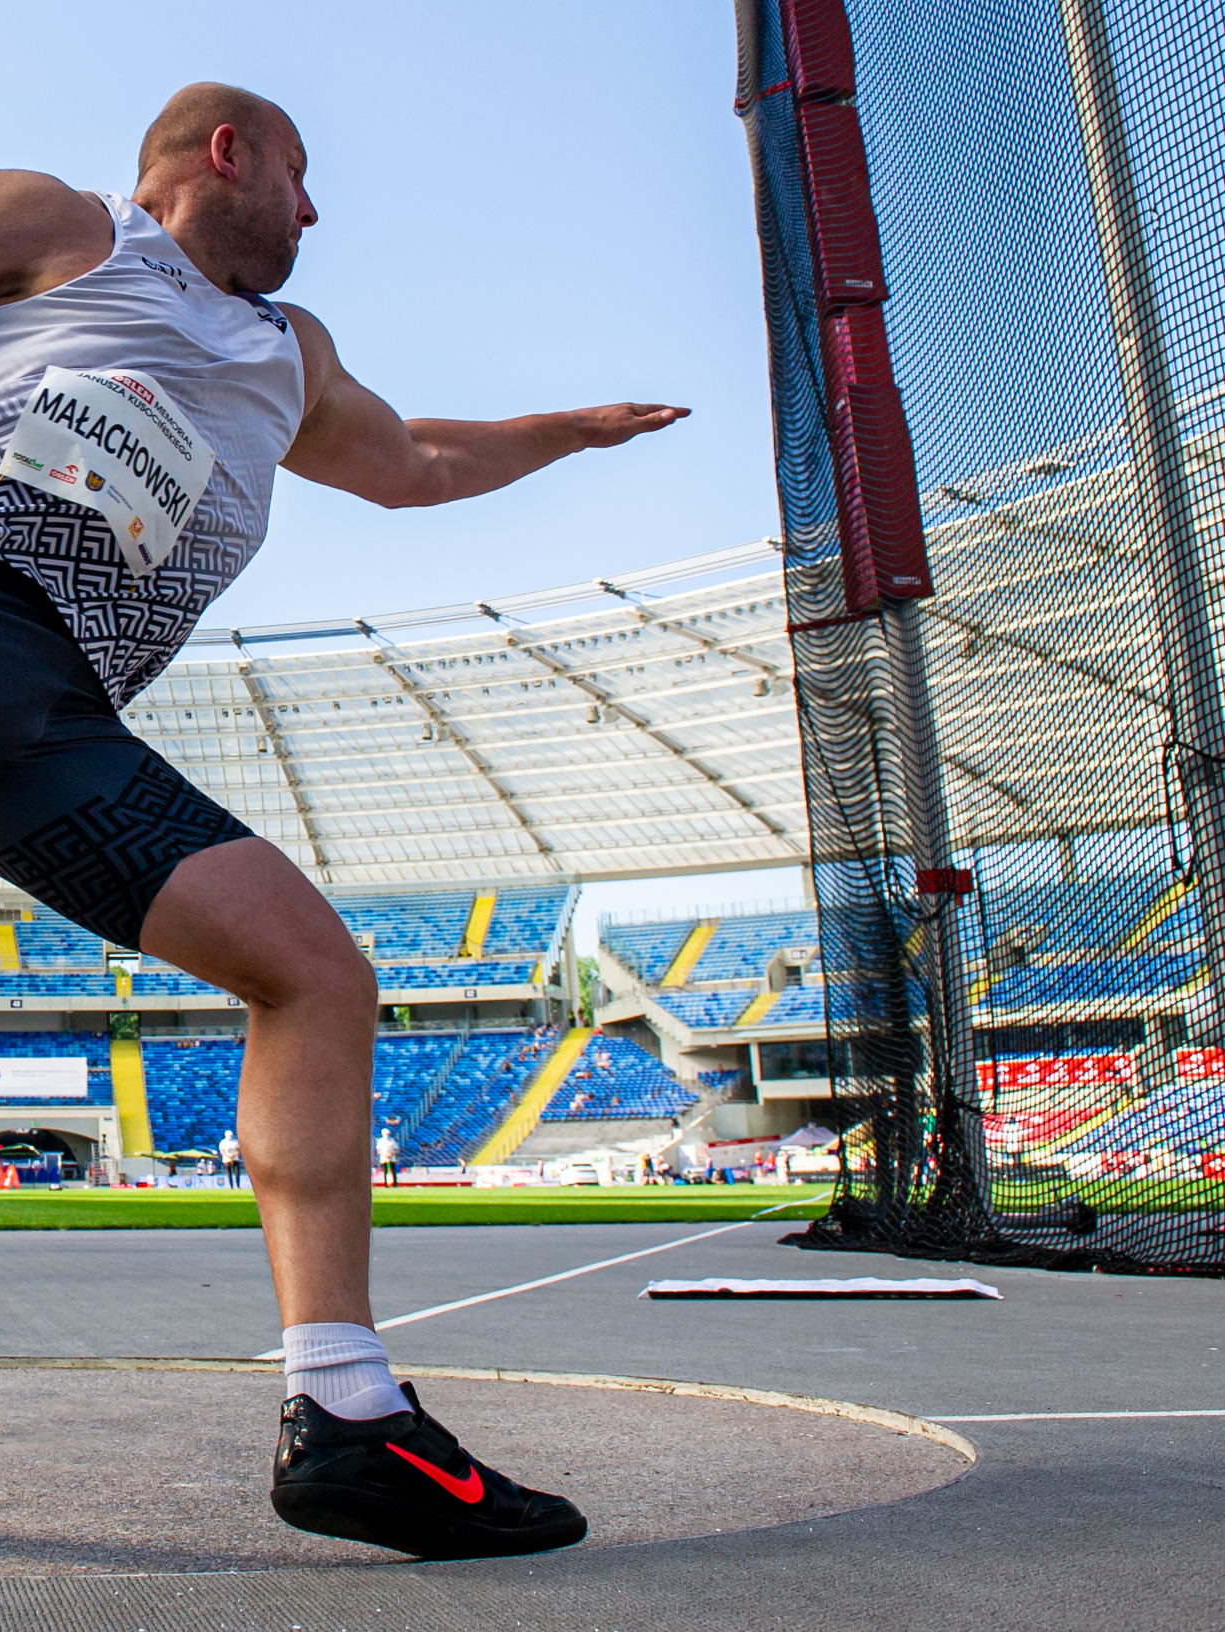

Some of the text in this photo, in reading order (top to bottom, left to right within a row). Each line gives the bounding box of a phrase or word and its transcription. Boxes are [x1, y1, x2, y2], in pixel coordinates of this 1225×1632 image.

[77, 373, 192, 461] JANUSZA KUSOCIŃSKIEGO
[114, 375, 193, 449] ORLEN MEMORIAŁ
[32, 388, 190, 528] MAŁACHOWSKI
